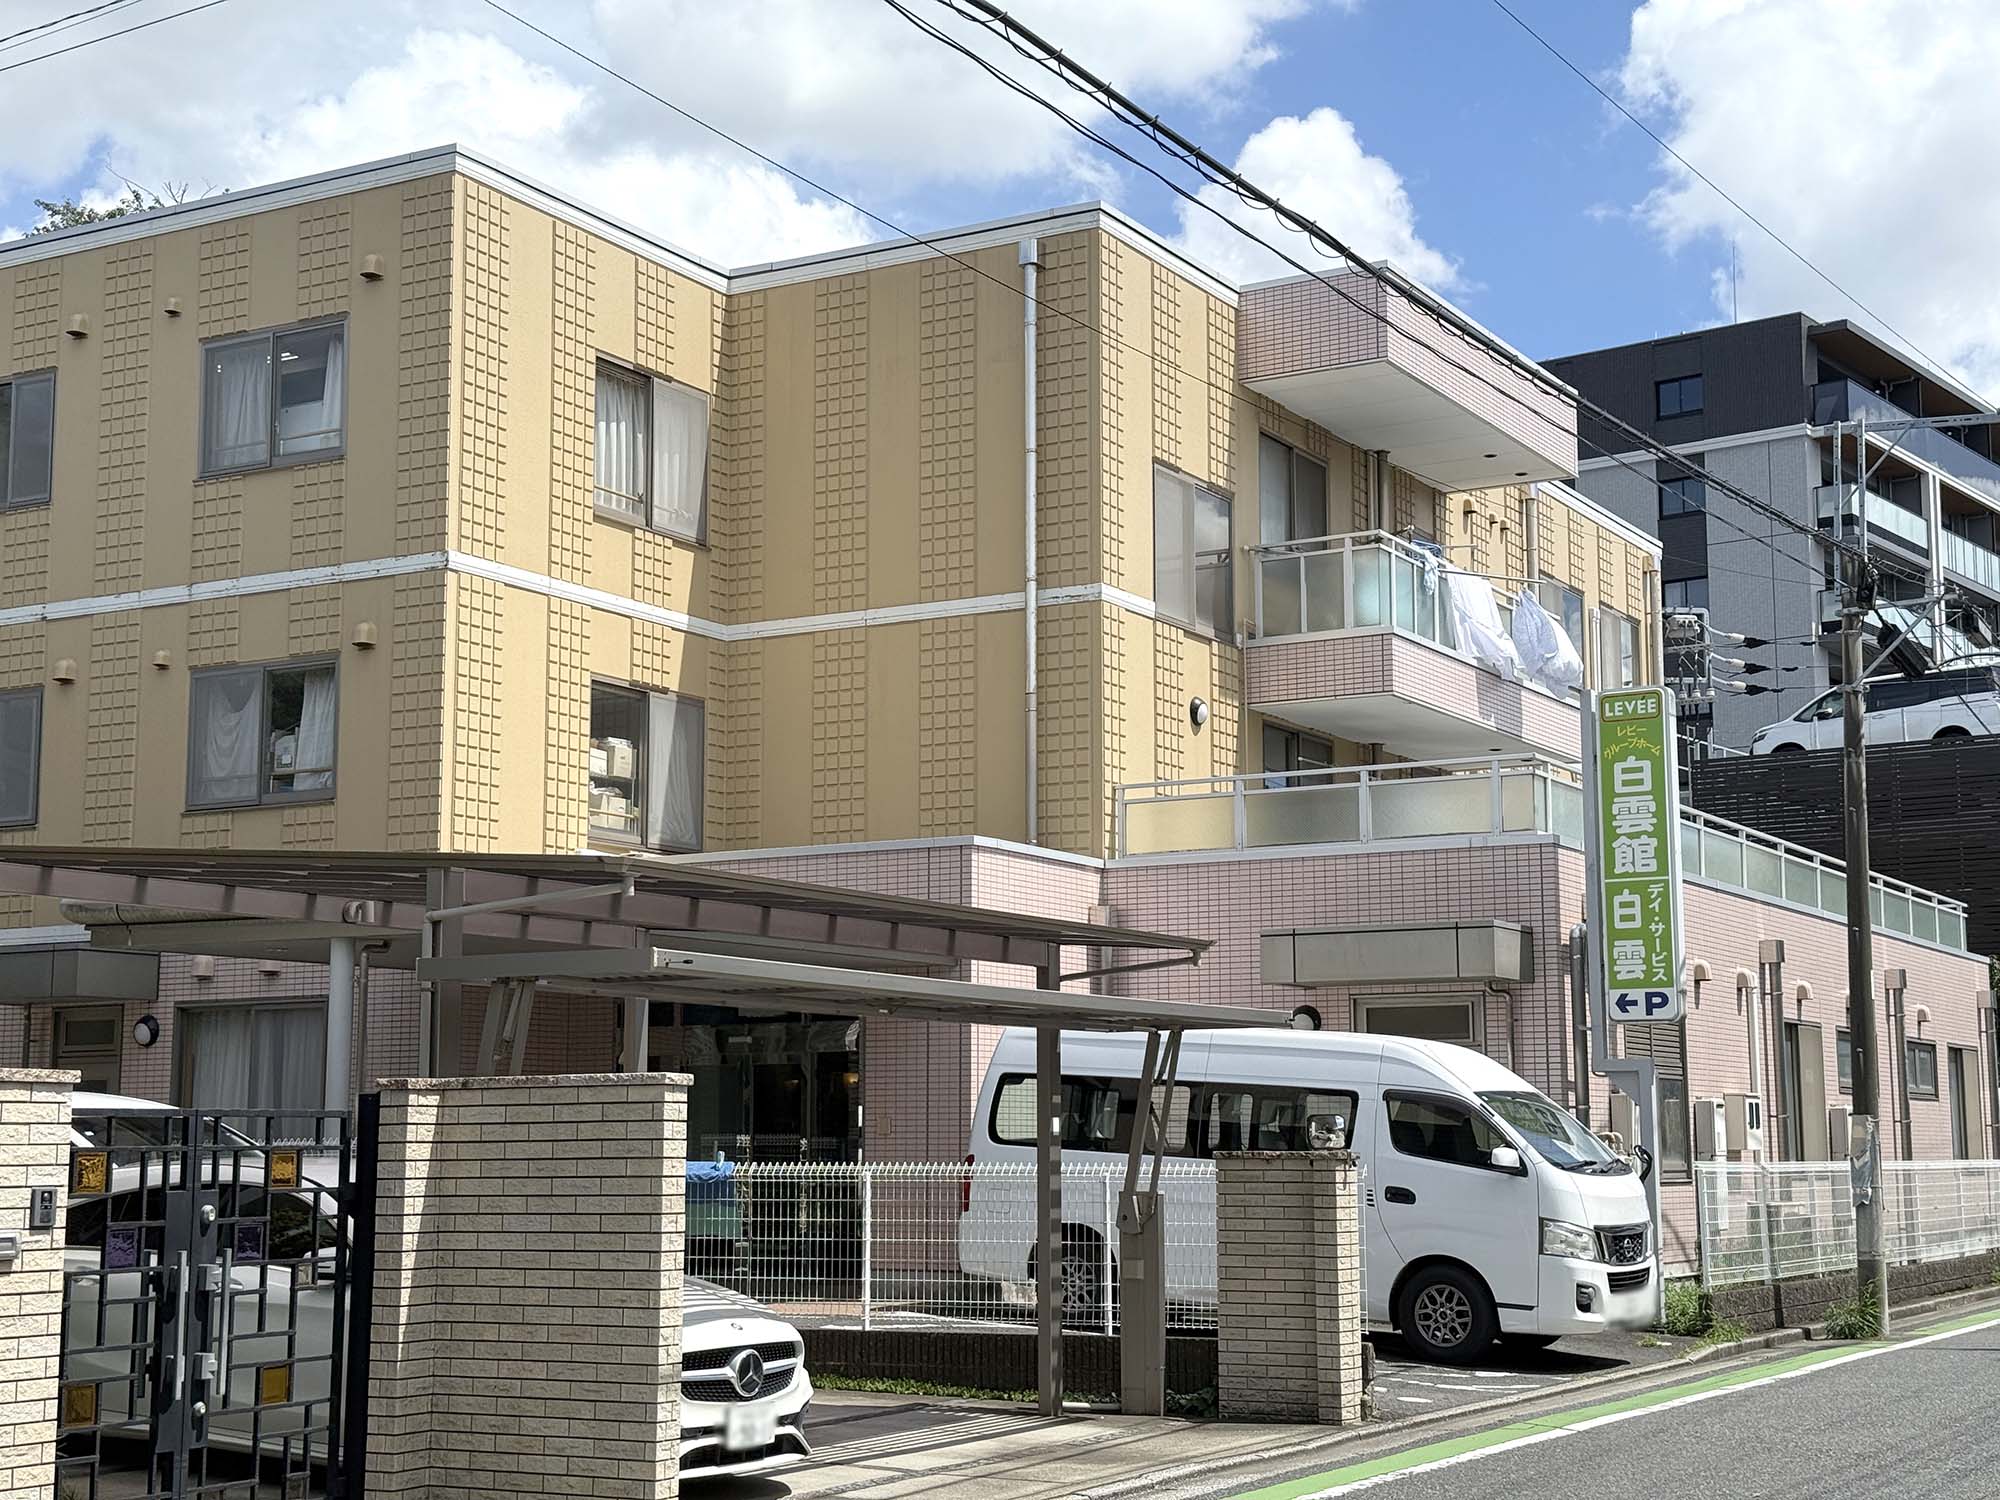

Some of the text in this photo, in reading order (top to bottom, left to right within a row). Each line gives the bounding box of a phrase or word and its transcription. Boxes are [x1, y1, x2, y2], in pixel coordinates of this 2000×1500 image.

[1616, 725, 1648, 736] レビー
[1612, 755, 1658, 874] 白雲館
[1613, 888, 1647, 981] 白雲
[1644, 991, 1670, 1016] P
